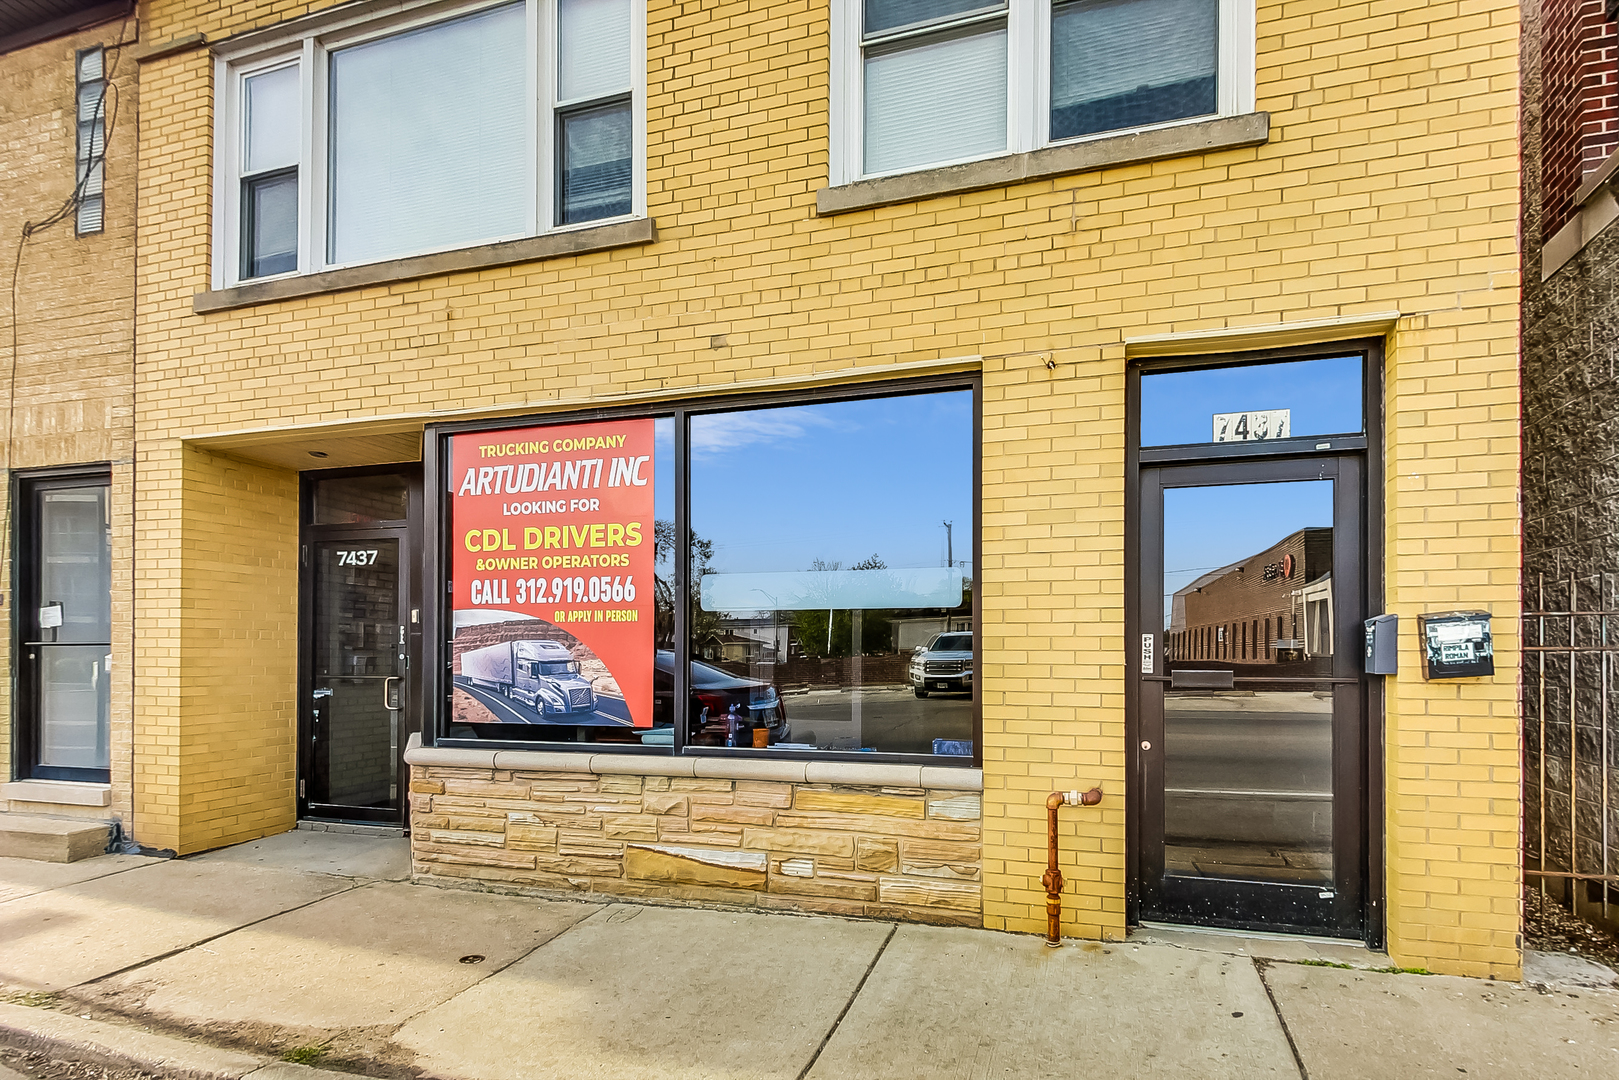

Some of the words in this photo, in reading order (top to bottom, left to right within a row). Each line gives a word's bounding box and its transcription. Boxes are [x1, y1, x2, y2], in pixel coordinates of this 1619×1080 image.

[479, 441, 549, 458] TRUCKING
[553, 435, 627, 453] COMPANY
[458, 458, 604, 496] ARTUDIANTI
[607, 455, 650, 488] INC
[503, 500, 567, 516] LOOKING
[570, 498, 600, 512] FOR
[464, 528, 517, 553] CDL
[524, 522, 643, 550] DRIVERS
[336, 550, 378, 566] 7437
[476, 557, 538, 571] &OWNER
[541, 553, 630, 569] OPERATORS
[471, 578, 510, 605] CALL
[516, 575, 636, 604] 312.919.0566
[554, 610, 566, 623] OR
[568, 610, 592, 622] APPLY
[594, 610, 604, 622] IN
[605, 609, 638, 622] PERSON
[1143, 636, 1152, 660] PUSH
